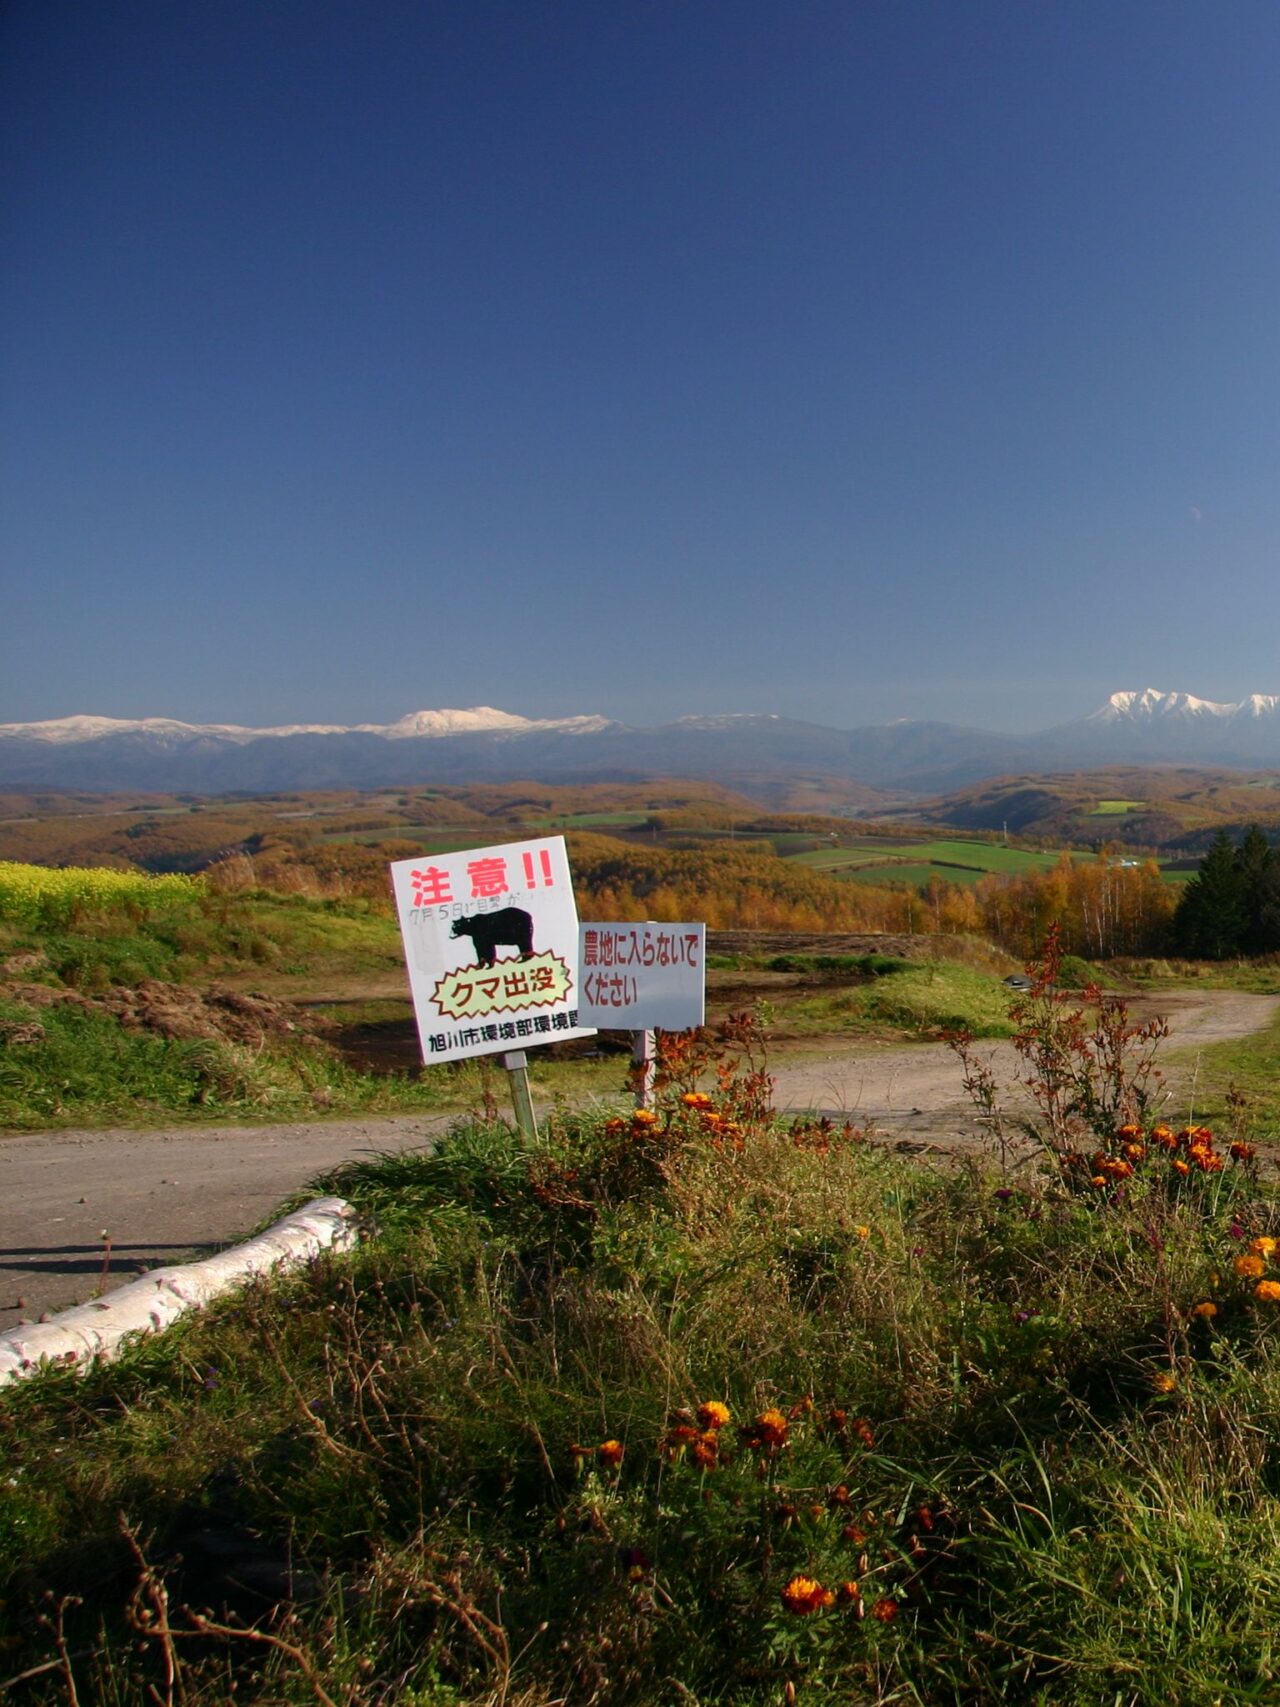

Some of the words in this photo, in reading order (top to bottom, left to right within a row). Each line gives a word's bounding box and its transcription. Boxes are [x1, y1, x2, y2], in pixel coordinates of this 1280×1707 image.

[584, 931, 699, 967] 農地に入らないで
[450, 966, 556, 1007] クマ出没
[584, 972, 637, 1007] ください
